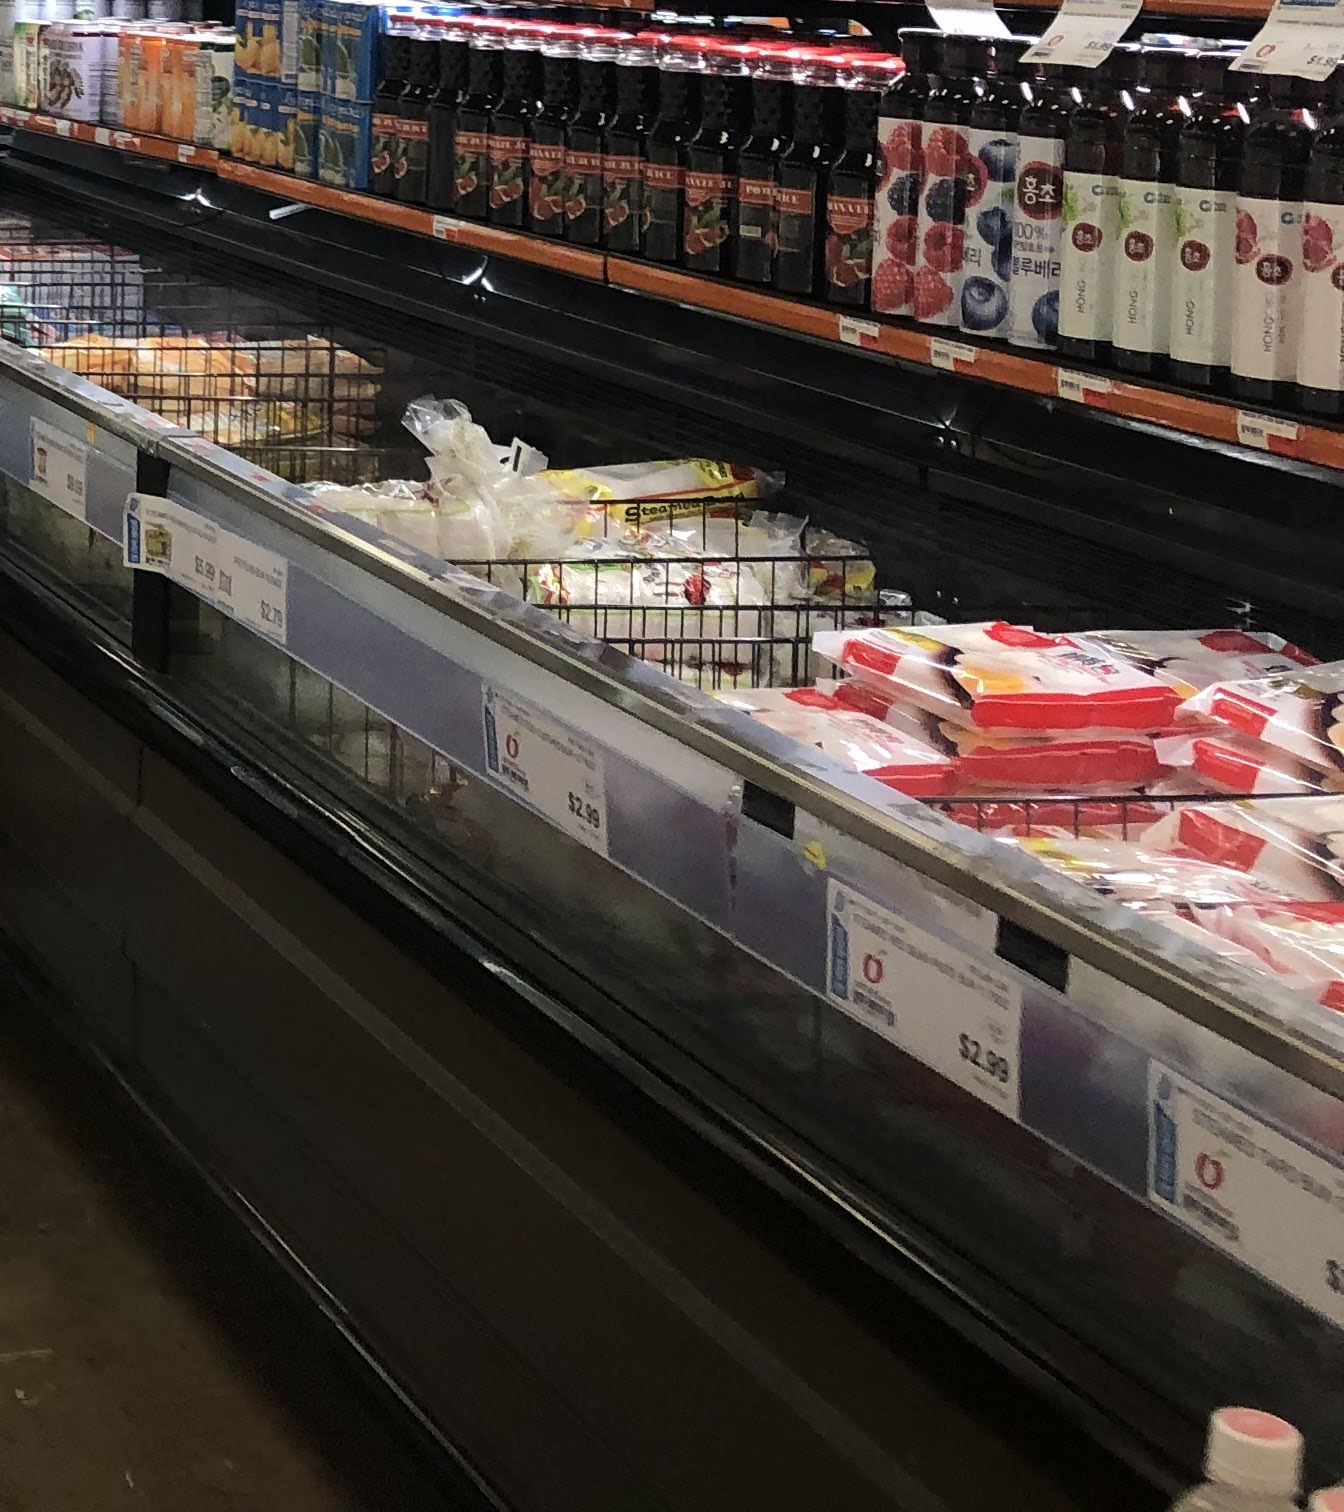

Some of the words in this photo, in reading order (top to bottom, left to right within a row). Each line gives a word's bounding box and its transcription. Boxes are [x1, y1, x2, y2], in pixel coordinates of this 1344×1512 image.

[1021, 174, 1058, 206] 홍초
[567, 790, 600, 830] $2.99
[958, 1031, 1009, 1085] $2.99
